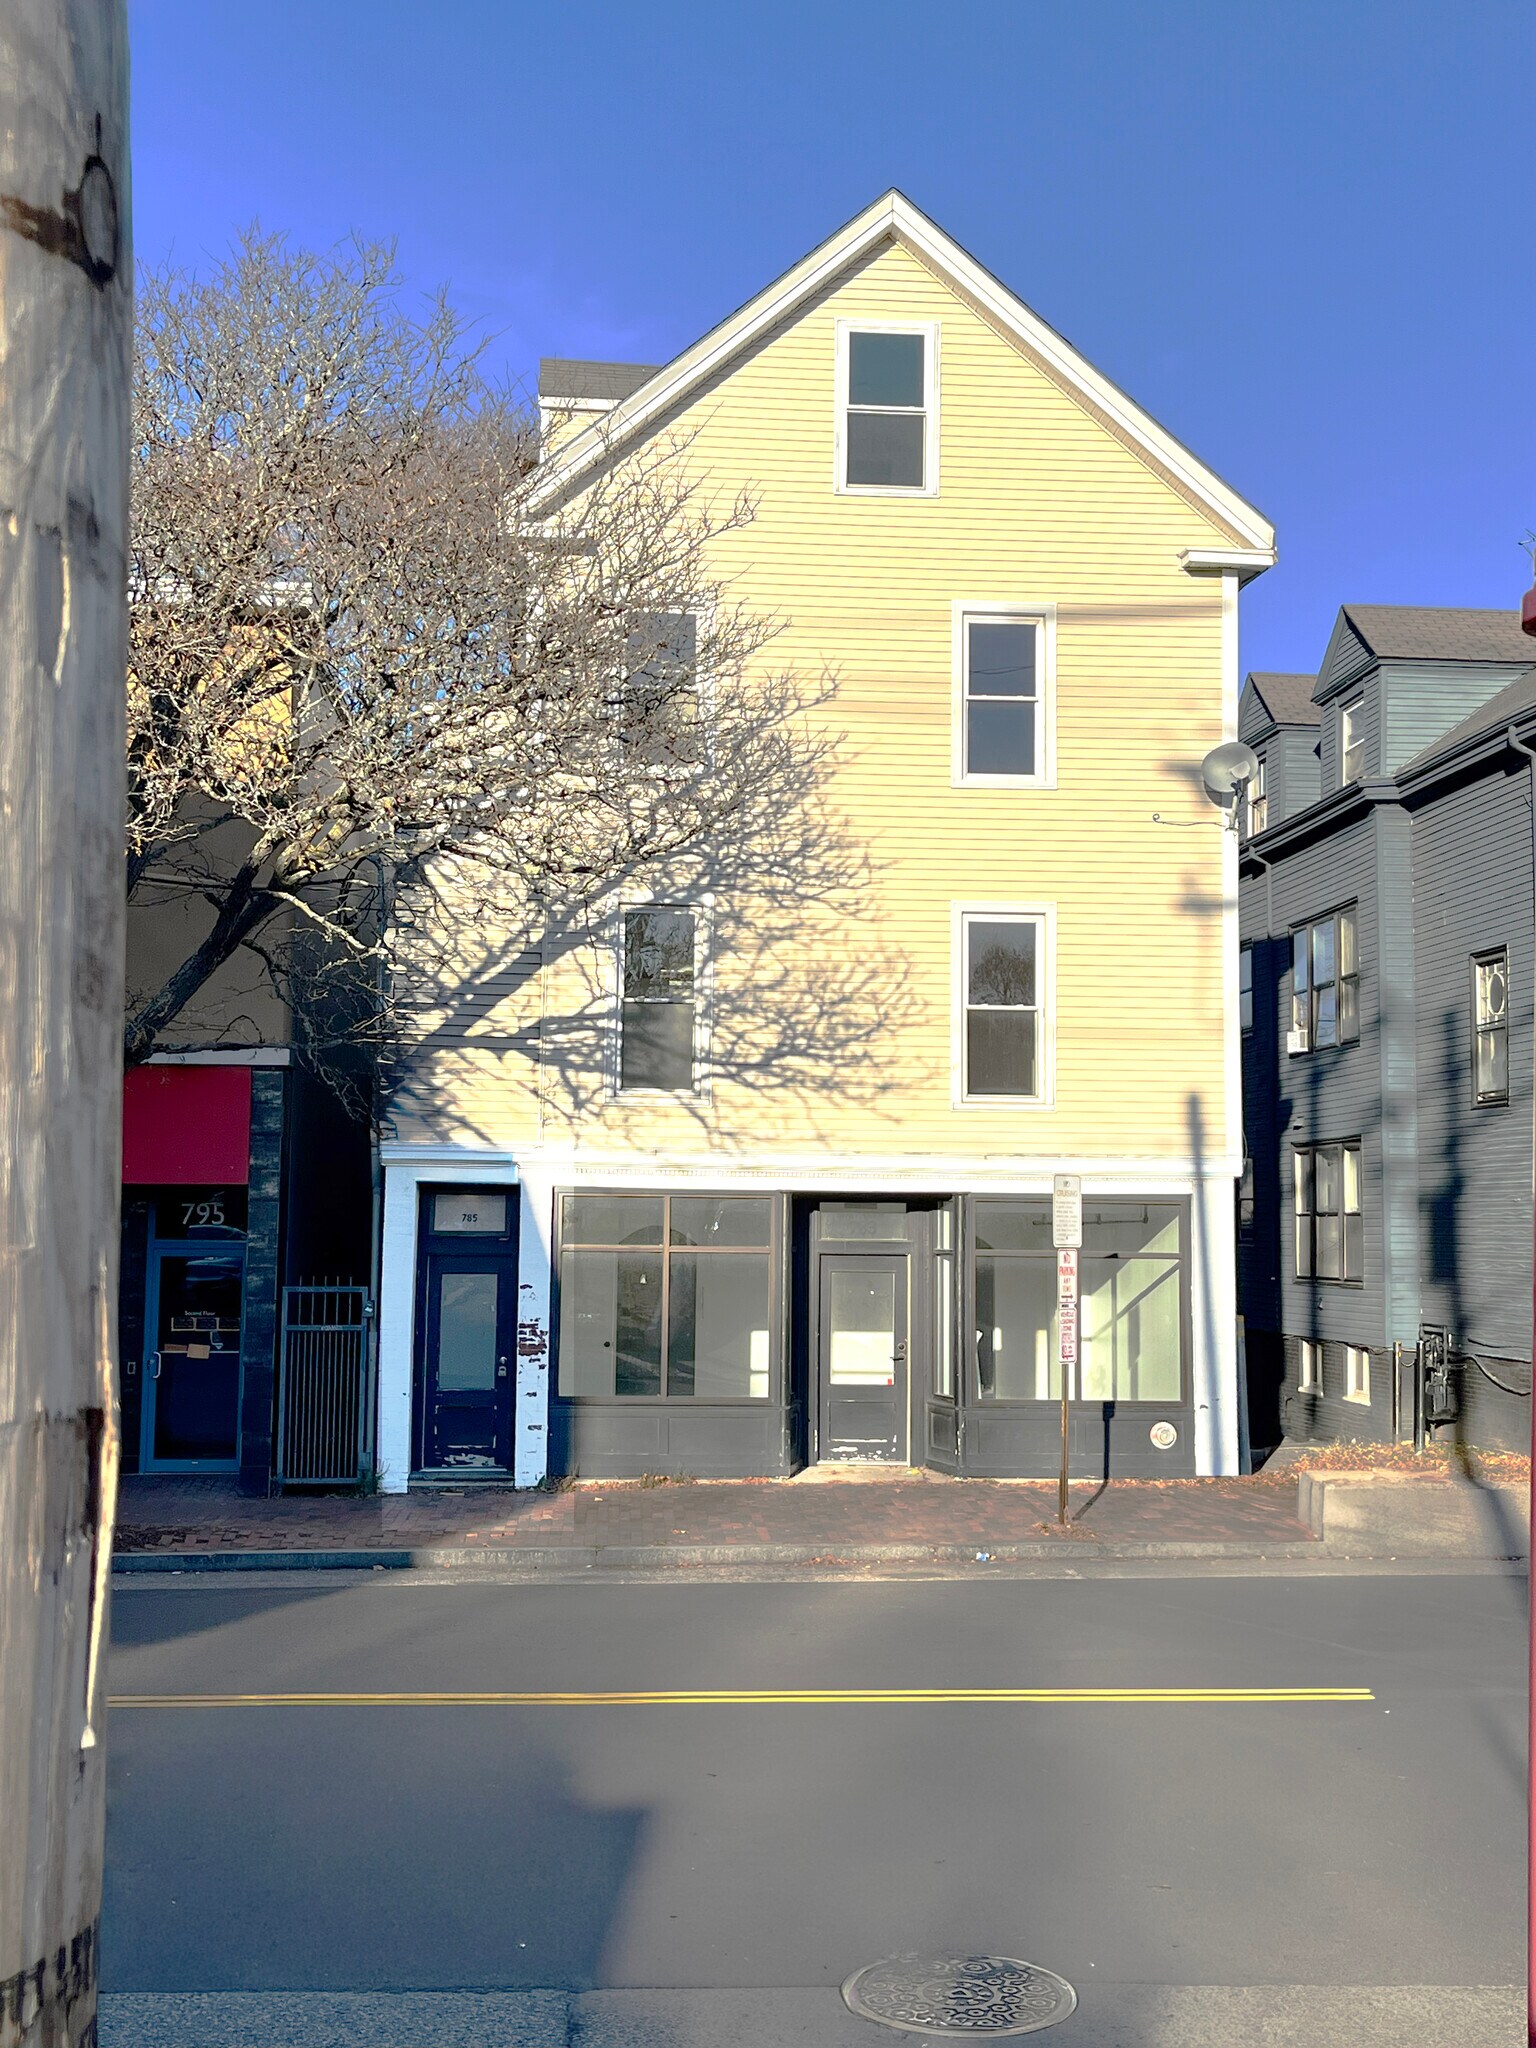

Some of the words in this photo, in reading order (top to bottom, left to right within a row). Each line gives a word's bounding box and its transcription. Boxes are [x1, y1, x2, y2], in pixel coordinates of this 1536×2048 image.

[181, 1203, 225, 1225] 795
[461, 1213, 478, 1223] 785
[1059, 1266, 1075, 1276] PARKING
